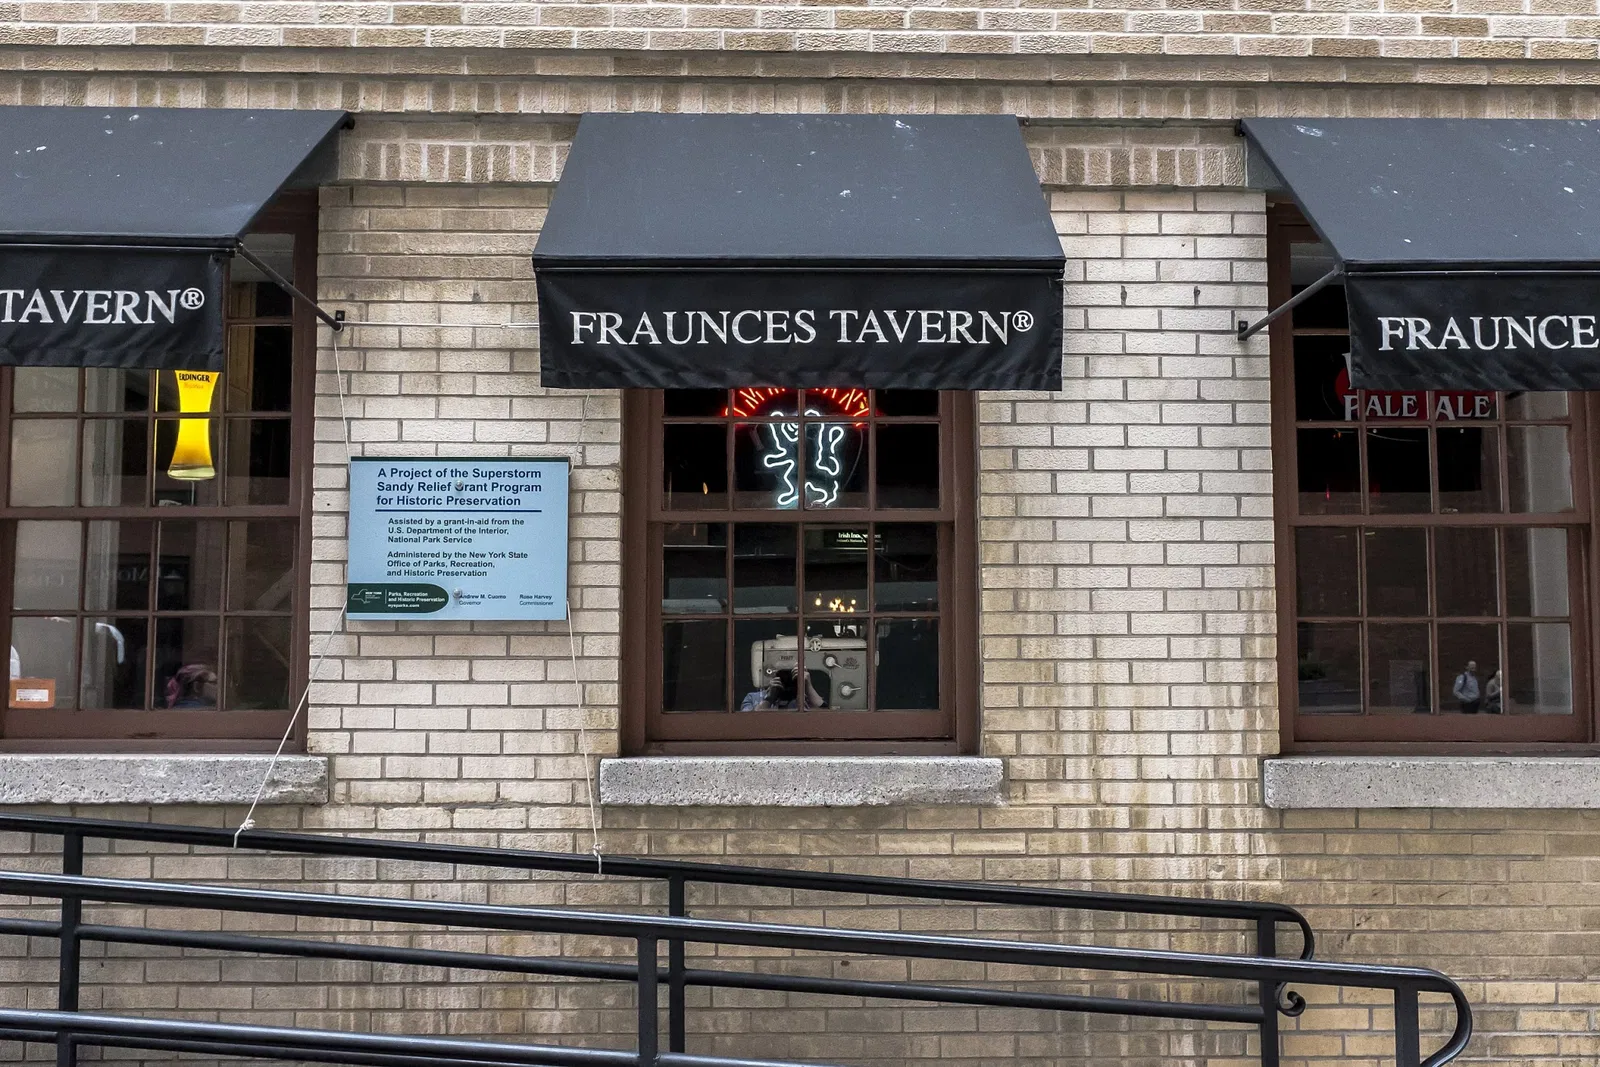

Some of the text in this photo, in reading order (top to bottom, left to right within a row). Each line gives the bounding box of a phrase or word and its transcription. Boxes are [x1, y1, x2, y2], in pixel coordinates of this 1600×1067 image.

[570, 309, 817, 345] FRAUNCES
[179, 373, 211, 383] ERDINGER
[1343, 395, 1491, 421] PALE ALE
[377, 467, 542, 480] A Project of the Superstorm
[377, 481, 414, 494] Sandy
[417, 481, 452, 492] Relief
[491, 482, 542, 494] Program
[377, 495, 521, 506] for Historic Preservation
[425, 518, 435, 526] by
[443, 518, 489, 527] grant-in-aid
[406, 527, 452, 536] Department
[478, 527, 510, 536] Interior,
[387, 551, 440, 559] Administered
[442, 551, 453, 560] by
[454, 551, 467, 559] the
[387, 560, 496, 569] Office of Parks, Recreation,
[386, 569, 488, 577] and Historic Preservation
